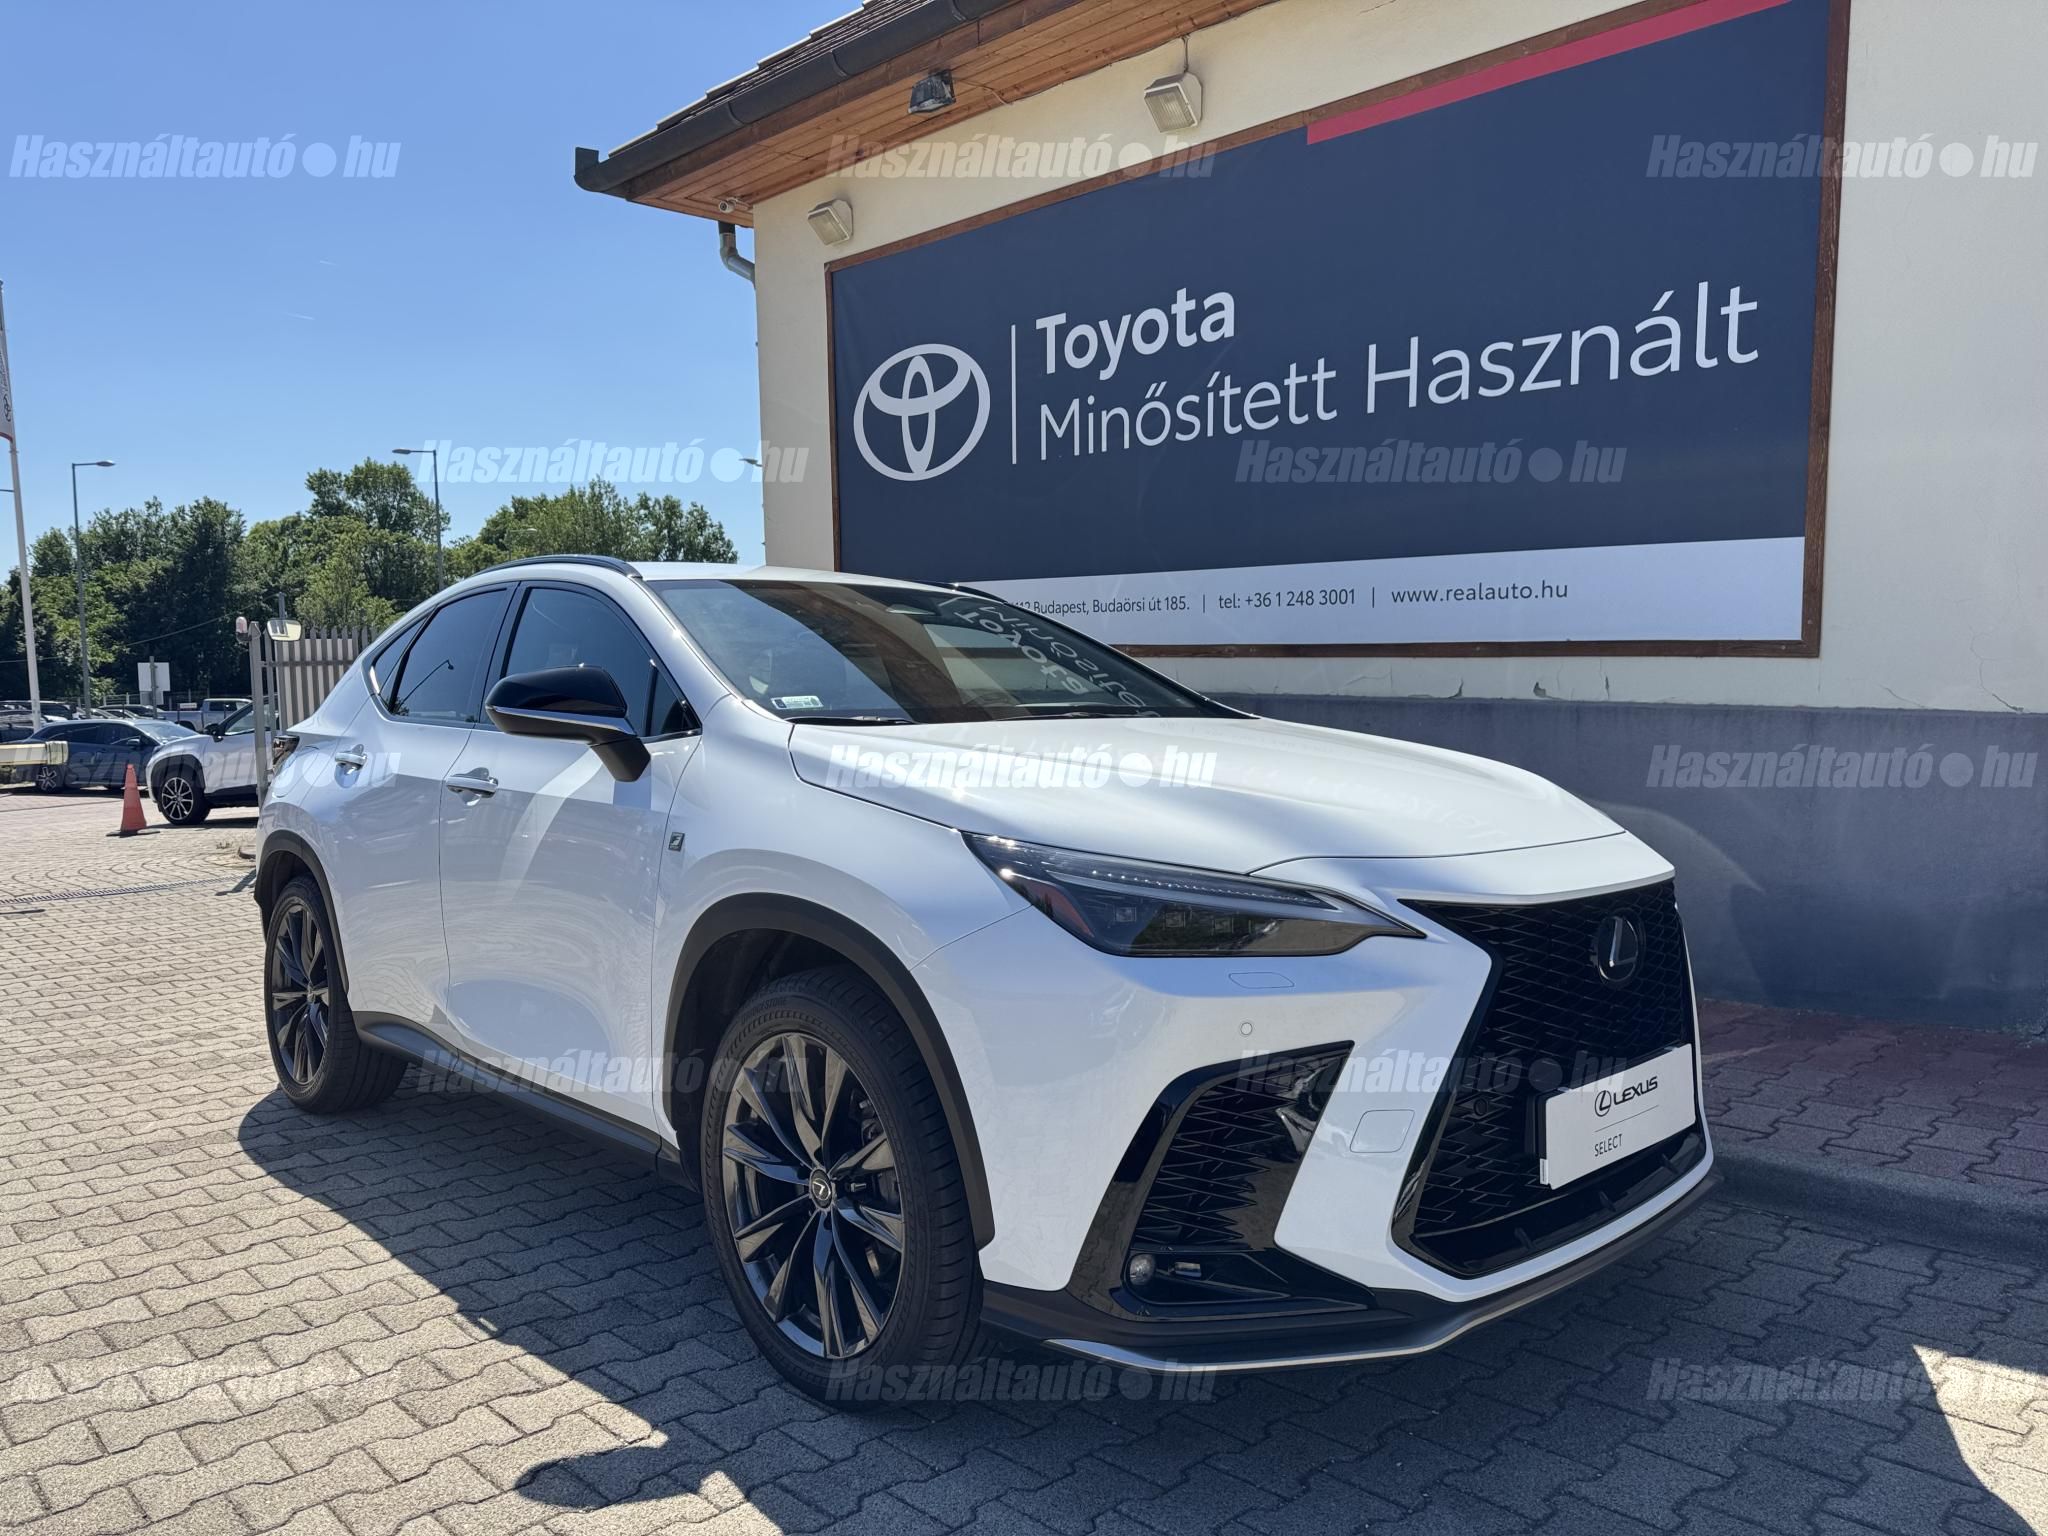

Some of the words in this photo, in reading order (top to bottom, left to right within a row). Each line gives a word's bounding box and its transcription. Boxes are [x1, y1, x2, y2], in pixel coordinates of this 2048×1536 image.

[1036, 287, 1236, 380] Toyota
[1040, 357, 1337, 461] Minősített
[1366, 281, 1759, 415] Használt
[1034, 600, 1089, 616] Budapest,
[1092, 597, 1146, 613] Budaörsi
[1148, 595, 1161, 611] út
[1165, 595, 1190, 611] 185.
[1219, 593, 1241, 609] tel:
[1245, 591, 1272, 608] +36
[1286, 590, 1315, 607] 248
[1319, 588, 1356, 605] 3001
[1391, 580, 1568, 603] www.realauto.hu
[1613, 1076, 1658, 1105] LEXUS
[1594, 1133, 1623, 1157] SELECT
